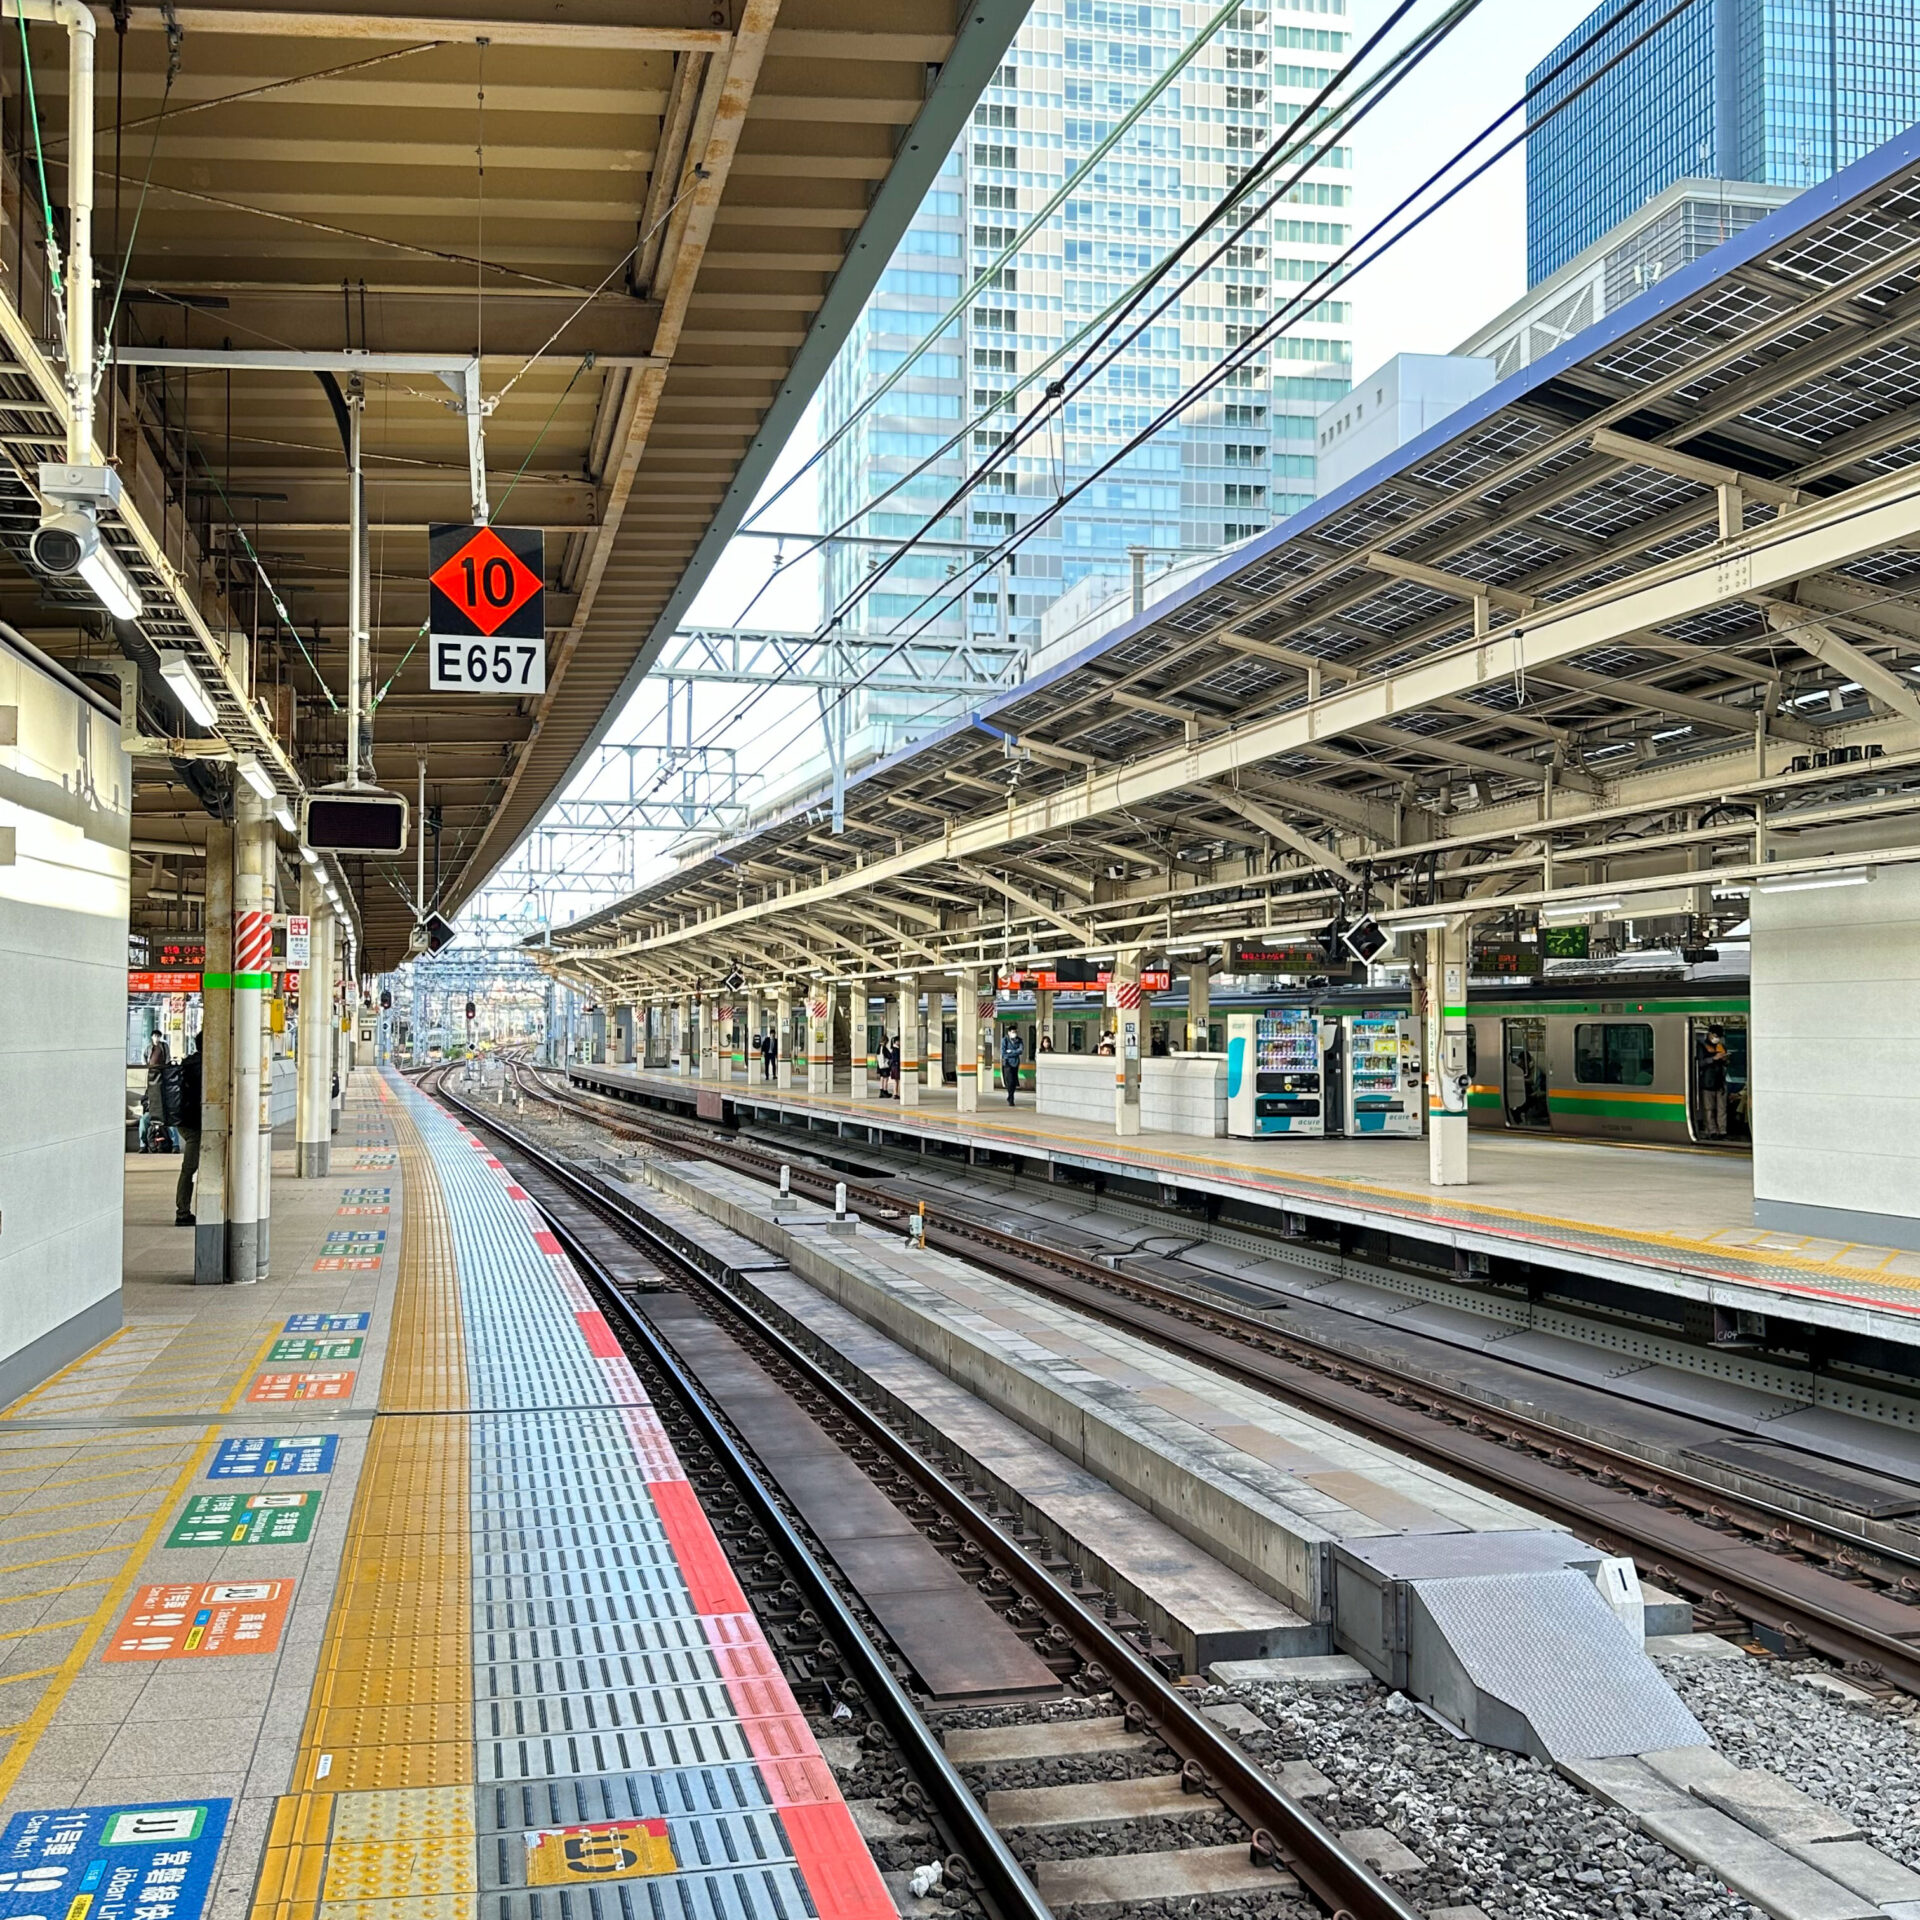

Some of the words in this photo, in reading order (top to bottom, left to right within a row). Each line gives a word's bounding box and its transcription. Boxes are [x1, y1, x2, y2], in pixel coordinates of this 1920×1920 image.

[461, 556, 516, 609] 10
[437, 641, 538, 684] E657
[289, 973, 300, 990] 8
[1155, 974, 1169, 990] 10
[162, 1585, 195, 1609] 11号車
[224, 1587, 258, 1599] JU
[210, 1606, 238, 1635] Takasaki
[232, 1612, 268, 1641] 高崎線
[203, 1635, 227, 1651] Line
[25, 1814, 50, 1835] Cars
[40, 1812, 91, 1857] 11号車
[132, 1818, 179, 1834] JJ
[10, 1833, 40, 1859] No.11
[564, 1833, 638, 1873] 5
[103, 1866, 139, 1902] Jōban
